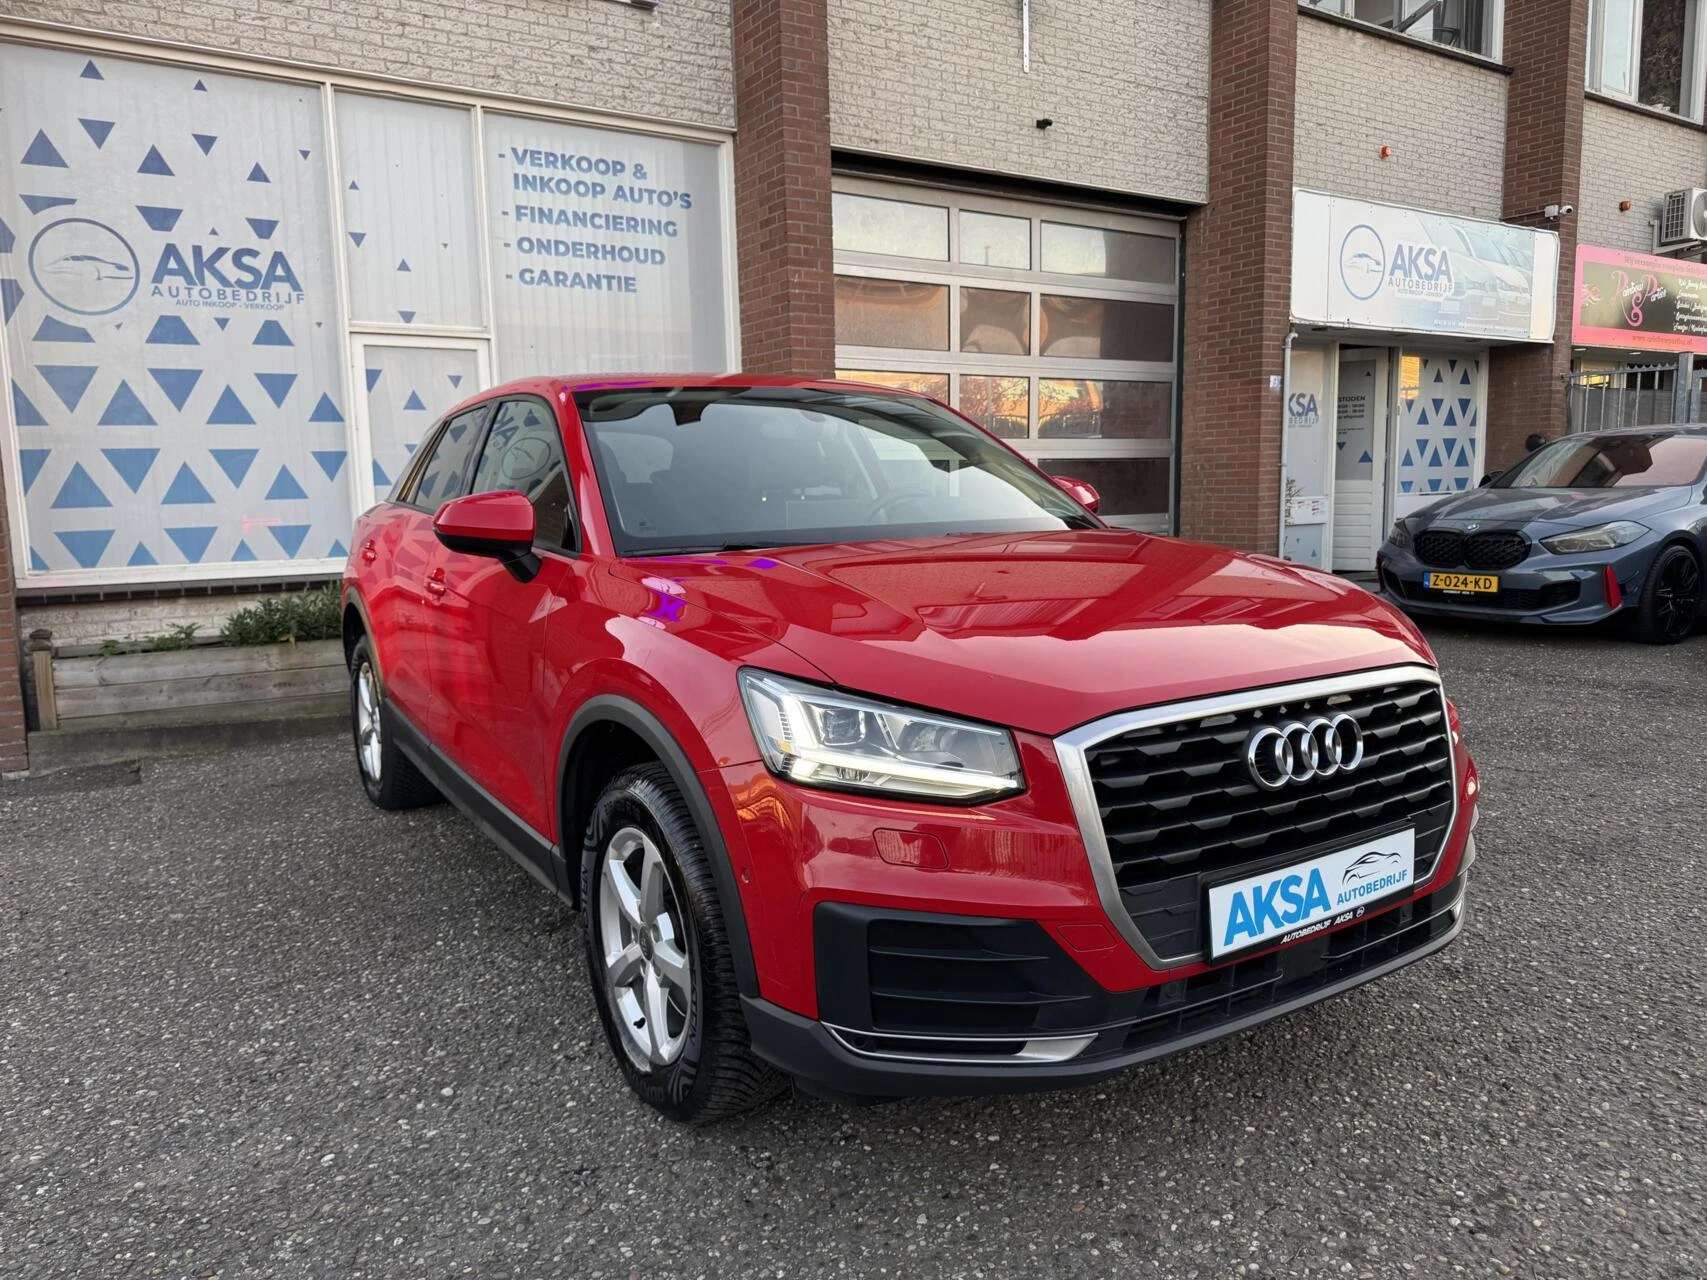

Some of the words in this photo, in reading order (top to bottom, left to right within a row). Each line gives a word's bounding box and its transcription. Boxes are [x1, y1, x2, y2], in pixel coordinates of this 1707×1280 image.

[511, 147, 626, 177] VERKOOP
[632, 163, 648, 180] &
[513, 173, 606, 199] INKOOP
[612, 184, 693, 210] AUTO'S
[515, 204, 678, 238] FINANCIERING
[151, 243, 304, 292] AKSA
[516, 236, 666, 266] ONDERHOUD
[1388, 244, 1453, 283] AKSA
[151, 285, 304, 304] AUTOBEDRIJF
[518, 268, 637, 293] GARANTIE
[1388, 277, 1454, 293] AUTOBEDRIJF
[176, 299, 200, 307] AUTO
[202, 300, 237, 309] INKOOP
[244, 302, 285, 311] VERKOOP
[1432, 574, 1492, 590] Z-024-KD
[1336, 869, 1407, 905] AUTOBEDRIJF
[1223, 868, 1332, 946] AKSA
[1280, 919, 1331, 944] AUTOBEDRIJF
[1334, 911, 1354, 925] AKSA
